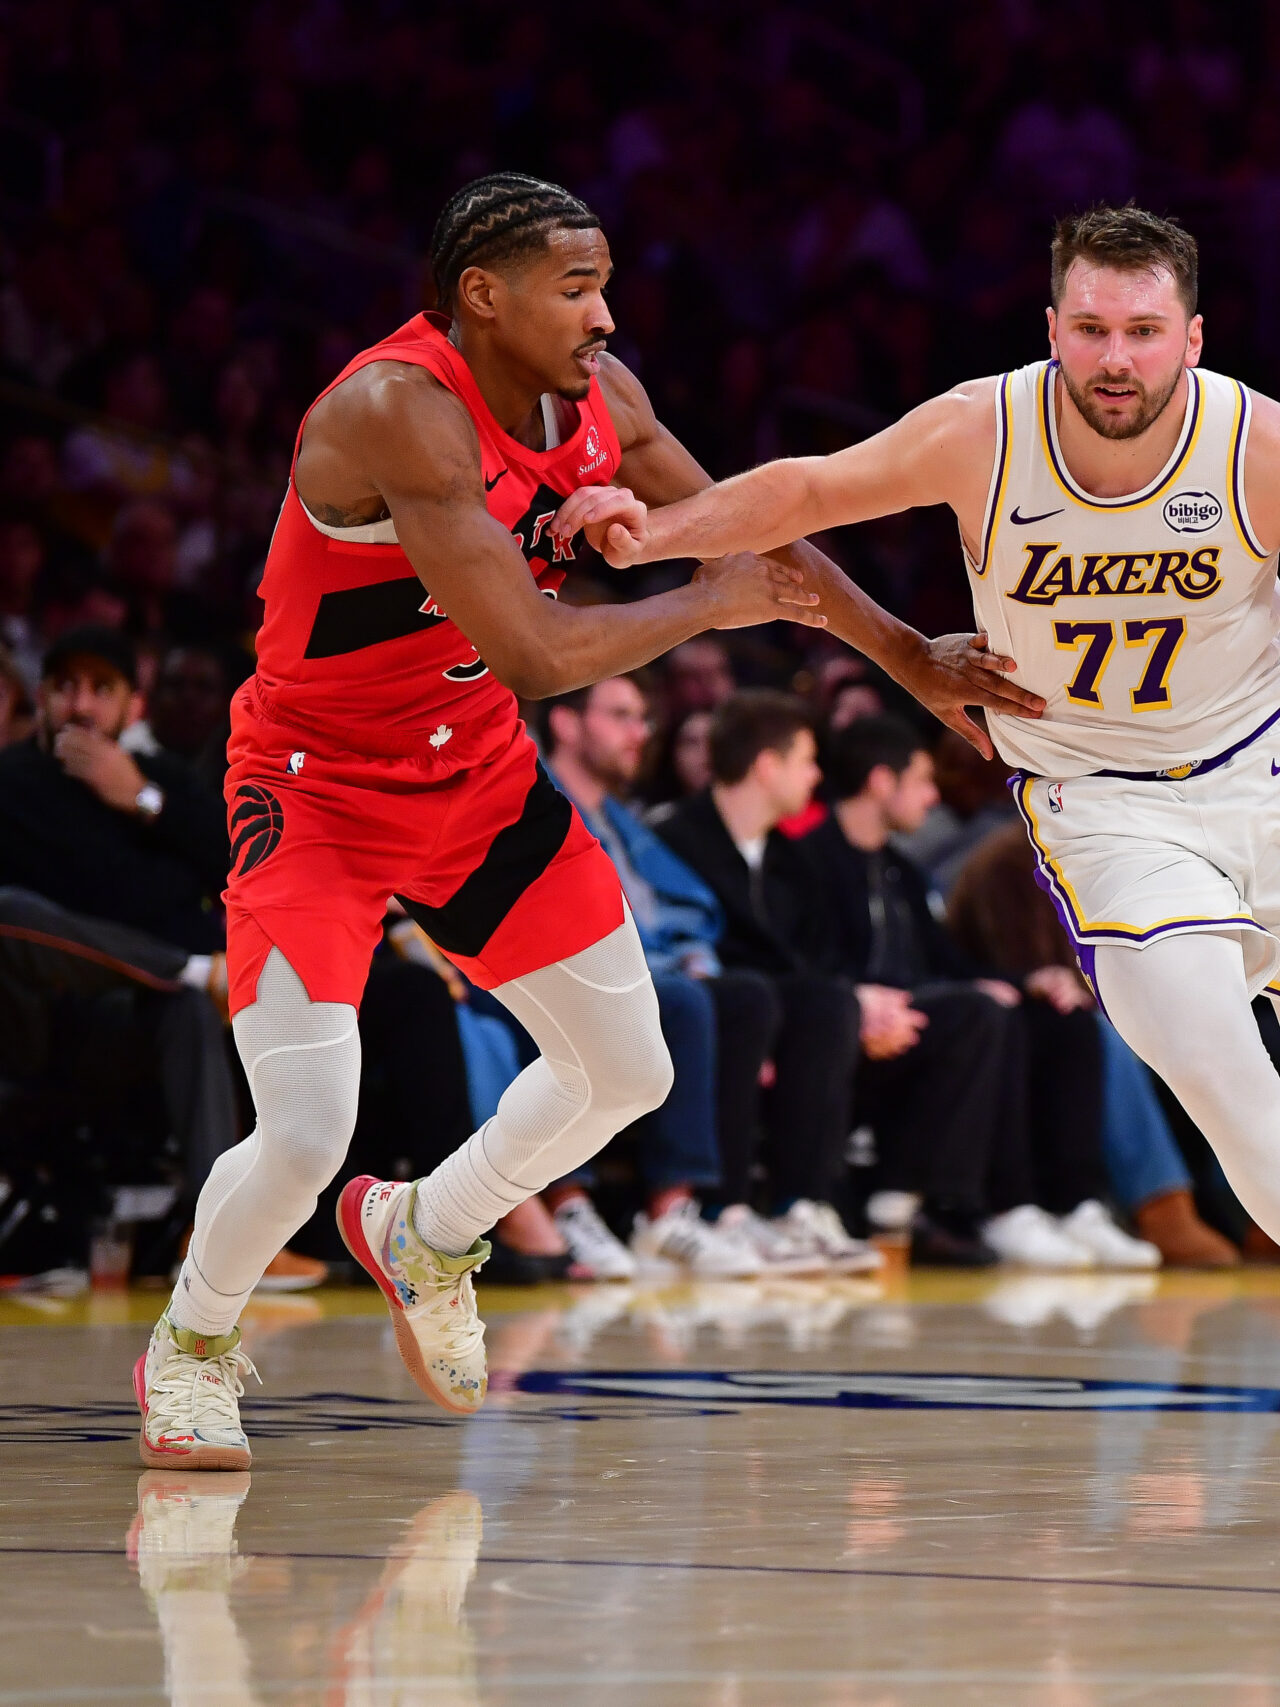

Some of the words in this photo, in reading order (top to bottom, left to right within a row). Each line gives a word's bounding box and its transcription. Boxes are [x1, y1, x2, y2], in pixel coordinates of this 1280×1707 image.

[578, 461, 596, 476] Sun
[596, 449, 608, 467] Life
[1168, 502, 1219, 521] bibigo
[1004, 541, 1225, 607] LAKERS
[1051, 615, 1188, 713] 77
